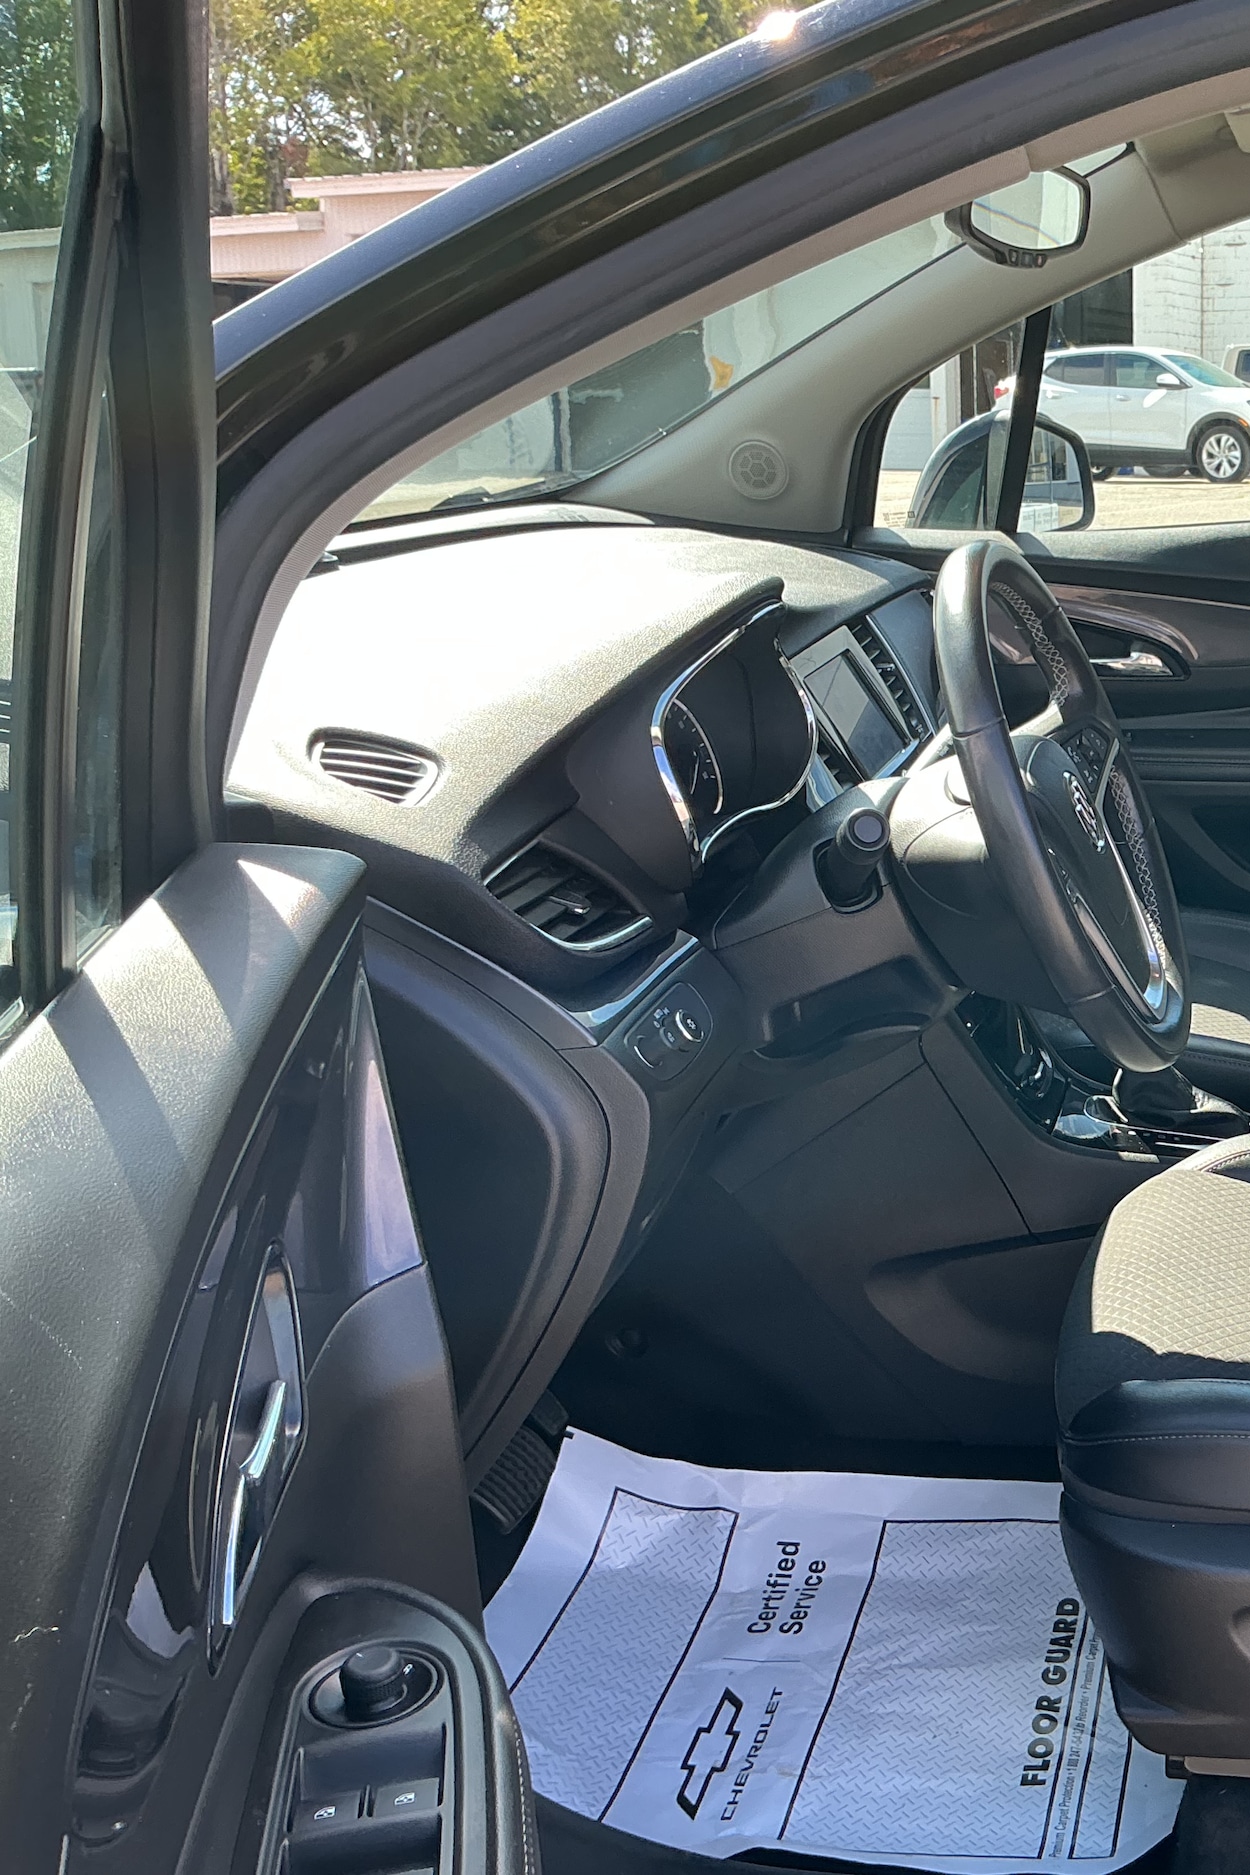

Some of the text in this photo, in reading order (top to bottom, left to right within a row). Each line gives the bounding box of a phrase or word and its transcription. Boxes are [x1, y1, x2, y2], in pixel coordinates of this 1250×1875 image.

[747, 1541, 800, 1634] Certified
[779, 1560, 826, 1634] Service
[1020, 1597, 1080, 1786] FLOOR GUARD
[1081, 1662, 1095, 1689] Premium
[1076, 1697, 1089, 1721] Reorder
[721, 1686, 783, 1820] CHEVROLET
[1058, 1776, 1075, 1808] Protection
[1054, 1808, 1071, 1831] Carpet
[1048, 1832, 1065, 1857] Premium
